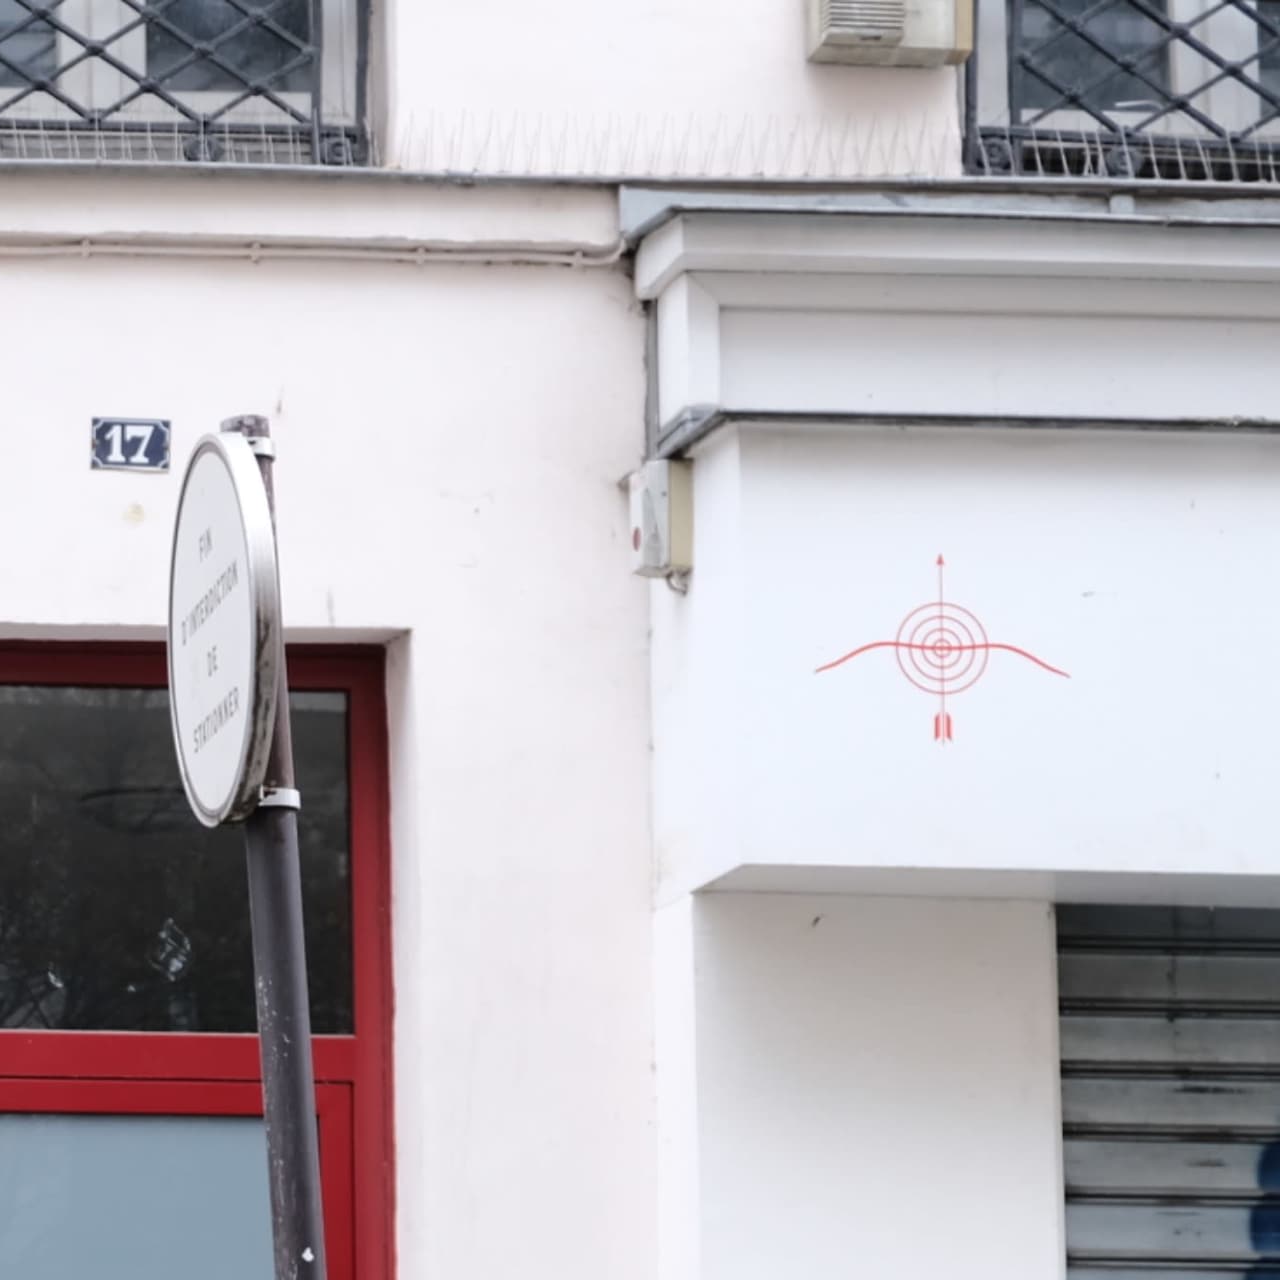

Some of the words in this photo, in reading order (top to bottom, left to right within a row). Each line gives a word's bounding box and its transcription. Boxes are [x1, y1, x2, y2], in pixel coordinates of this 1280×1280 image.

[105, 425, 154, 463] 17
[198, 527, 213, 562] FIN
[181, 560, 239, 647] D'INTERDICTION
[206, 645, 219, 677] DE
[193, 686, 240, 753] STATIONNER
